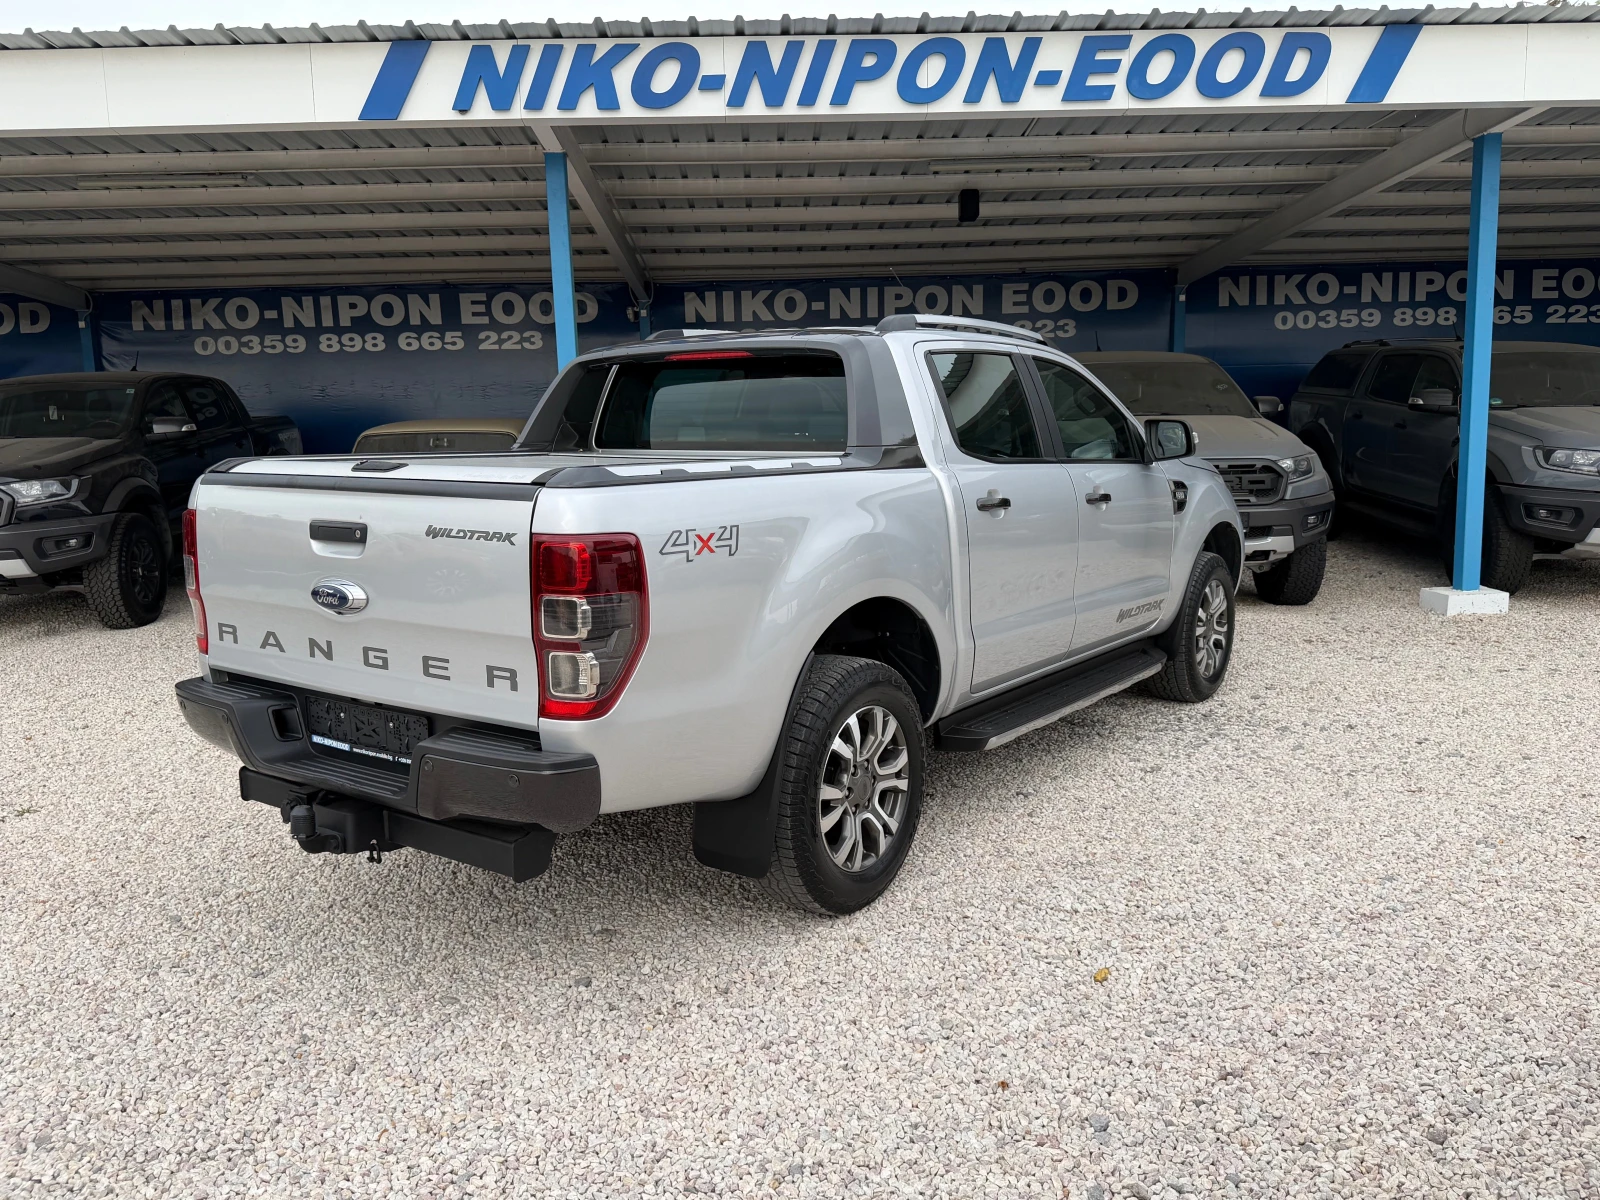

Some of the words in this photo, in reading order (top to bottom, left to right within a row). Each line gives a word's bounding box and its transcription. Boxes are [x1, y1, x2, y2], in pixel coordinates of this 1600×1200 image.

[451, 31, 1332, 111] NIKO-NIPON-EOOD
[131, 293, 442, 331] NIKO-NIPON
[684, 284, 983, 323] NIKO-NIPON
[1001, 280, 1139, 314] EOOD
[1274, 308, 1381, 330] 00359
[1393, 306, 1457, 327] 898
[194, 333, 306, 356] 00359
[318, 332, 386, 353] 898
[397, 331, 465, 351] 665
[478, 330, 543, 350] 223
[425, 525, 519, 546] WILDTRAK
[317, 588, 340, 605] Ford
[1116, 598, 1165, 623] WILDTRAK
[217, 622, 519, 692] RANGER
